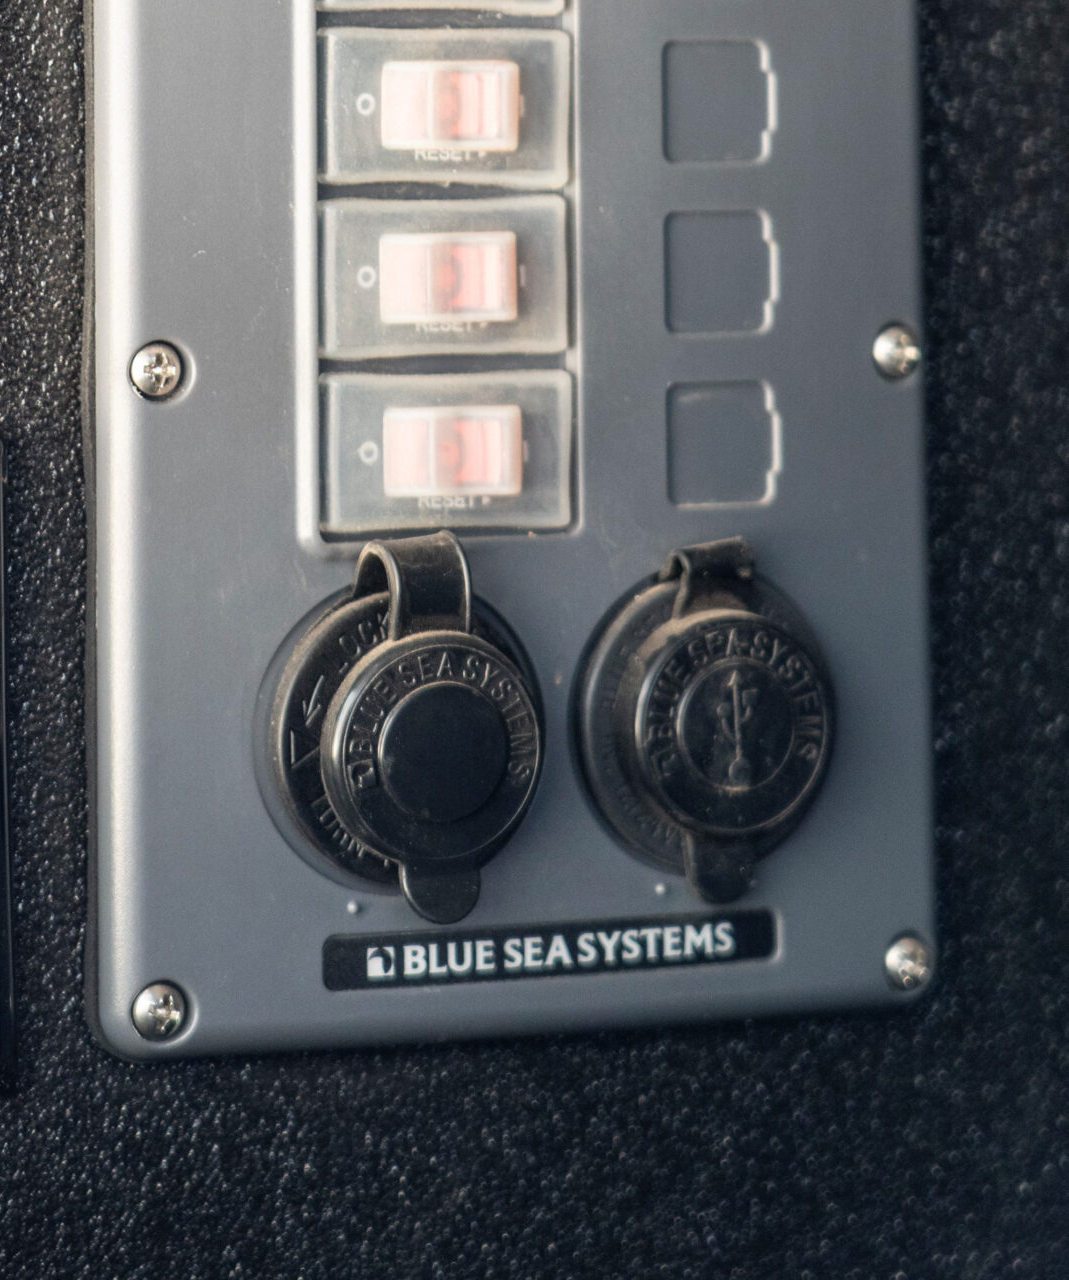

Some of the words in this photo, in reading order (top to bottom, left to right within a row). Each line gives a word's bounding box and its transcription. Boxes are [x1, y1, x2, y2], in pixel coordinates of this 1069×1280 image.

[398, 651, 453, 687] SEA
[462, 654, 531, 787] SYSTEMS
[403, 939, 496, 974] BLUE
[503, 933, 572, 970] SEA
[577, 922, 735, 966] SYSTEMS
